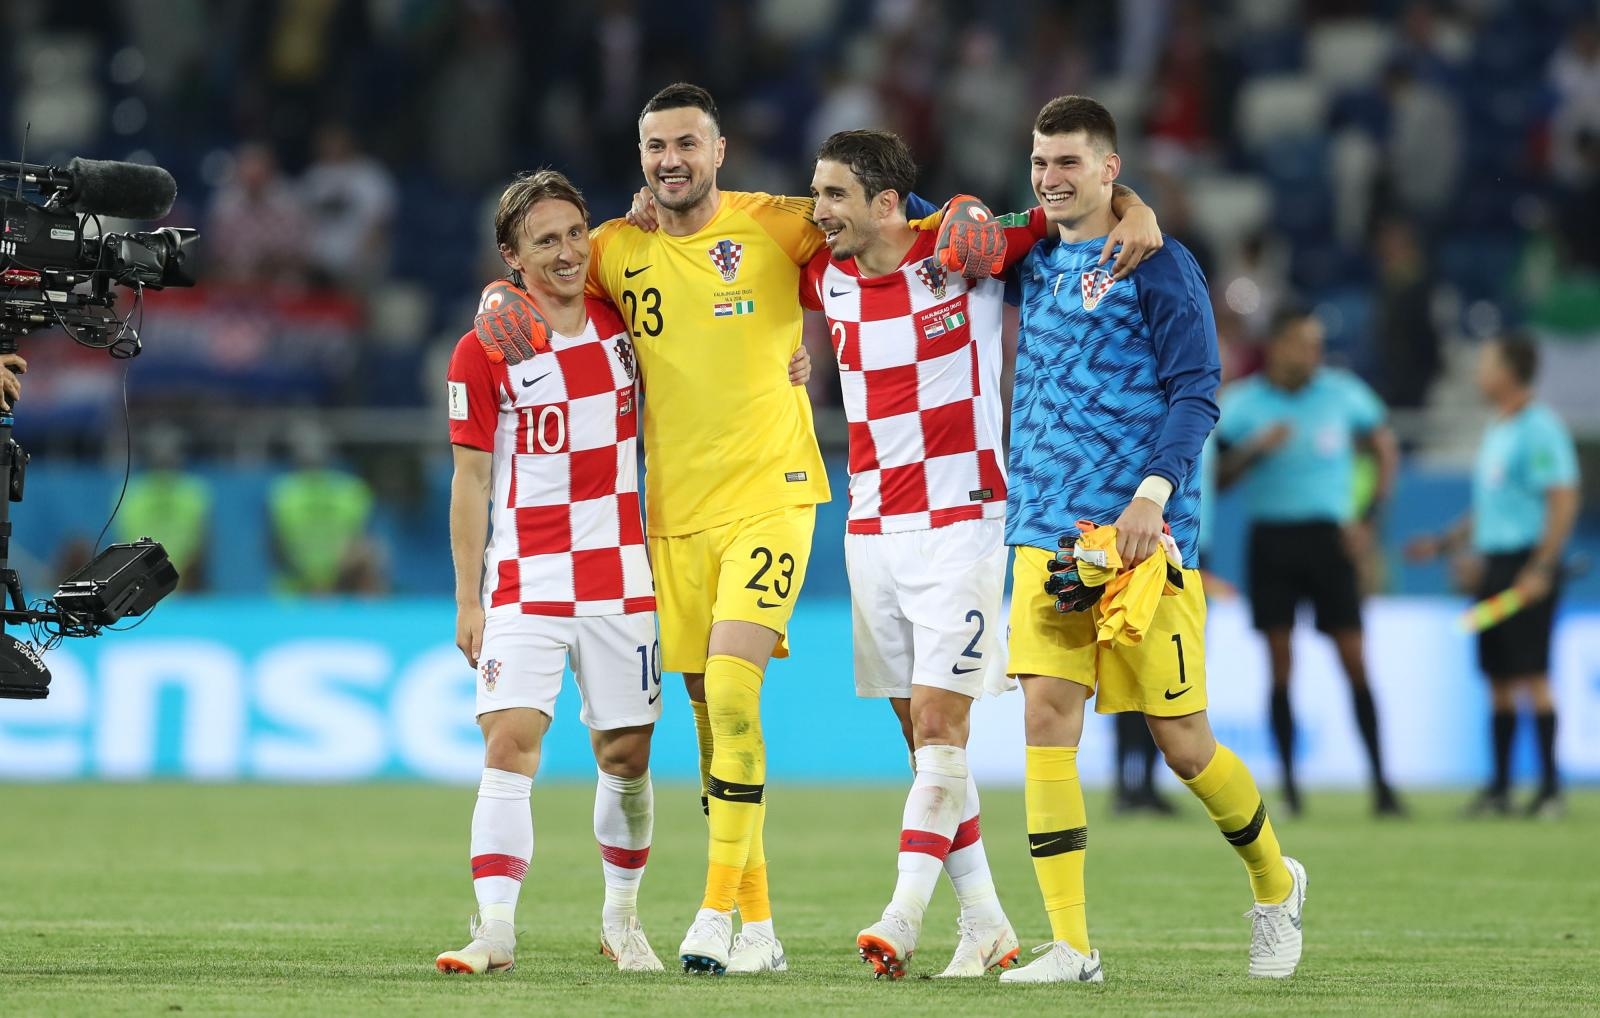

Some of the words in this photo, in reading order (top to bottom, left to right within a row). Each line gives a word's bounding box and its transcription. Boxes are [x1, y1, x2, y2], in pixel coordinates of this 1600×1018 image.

[1053, 273, 1064, 297] 1
[622, 287, 664, 338] 23
[831, 321, 850, 371] 2
[521, 405, 566, 454] 10
[744, 546, 796, 599] 23
[13, 640, 47, 673] STEADICAM
[960, 609, 985, 659] 2
[1171, 633, 1186, 684] 1
